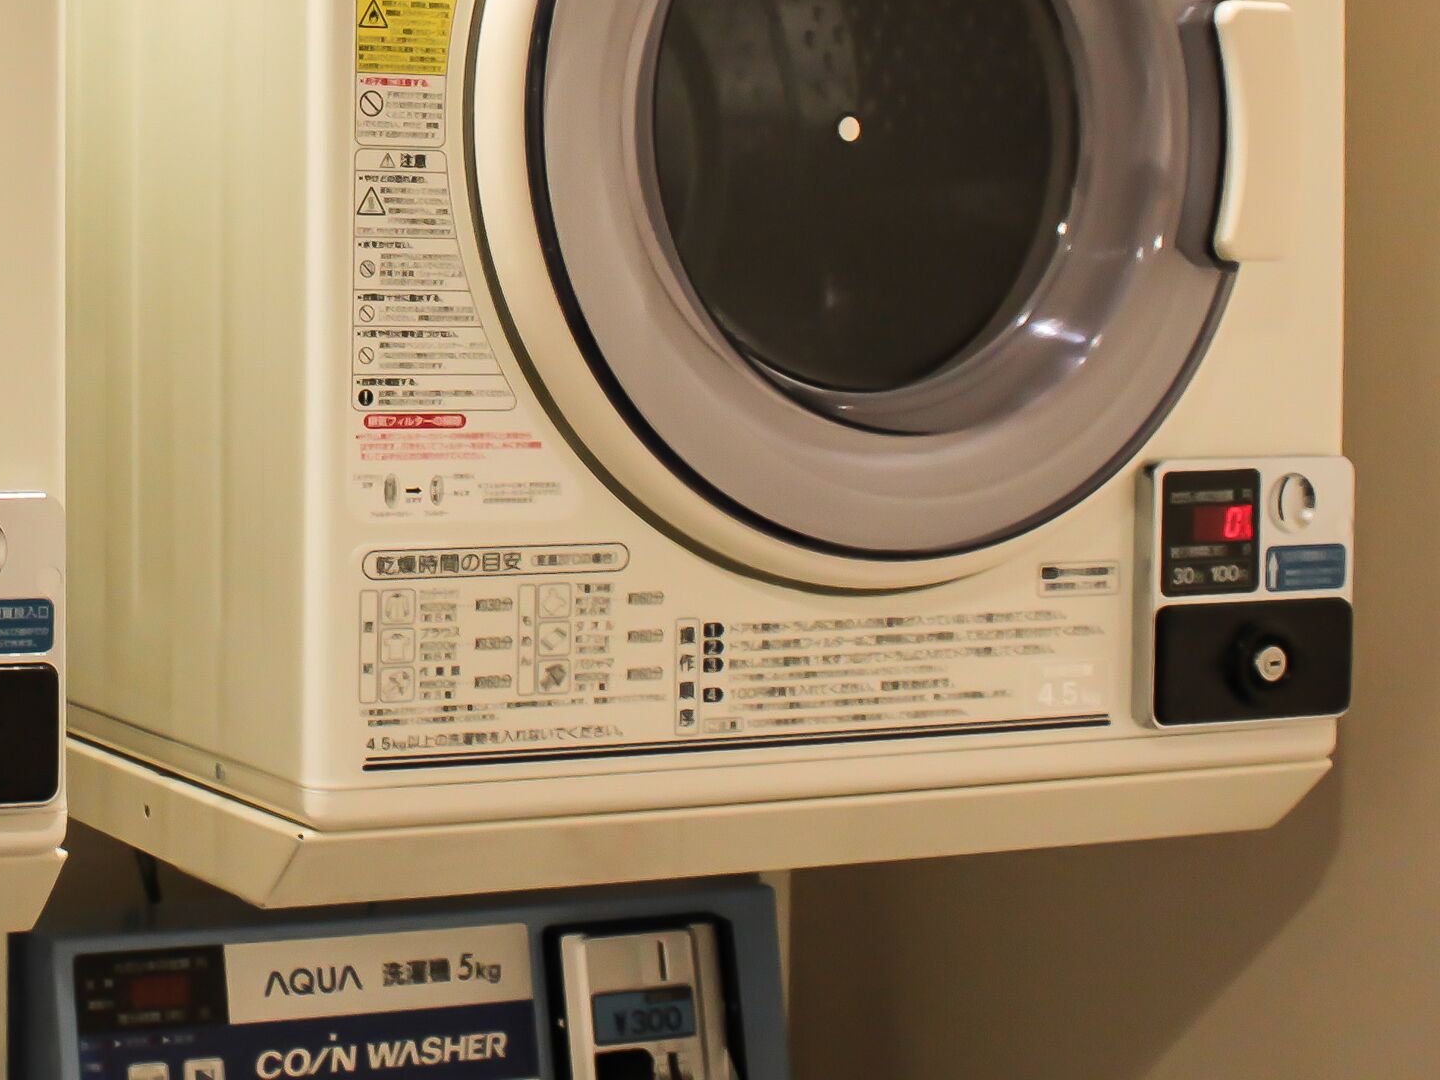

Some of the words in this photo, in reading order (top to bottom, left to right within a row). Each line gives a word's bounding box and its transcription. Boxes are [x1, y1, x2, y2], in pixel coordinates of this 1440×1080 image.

[264, 964, 365, 998] AQUA
[382, 956, 451, 987] 洗濯機
[456, 953, 502, 985] 5kg
[366, 1031, 508, 1072] WASHER
